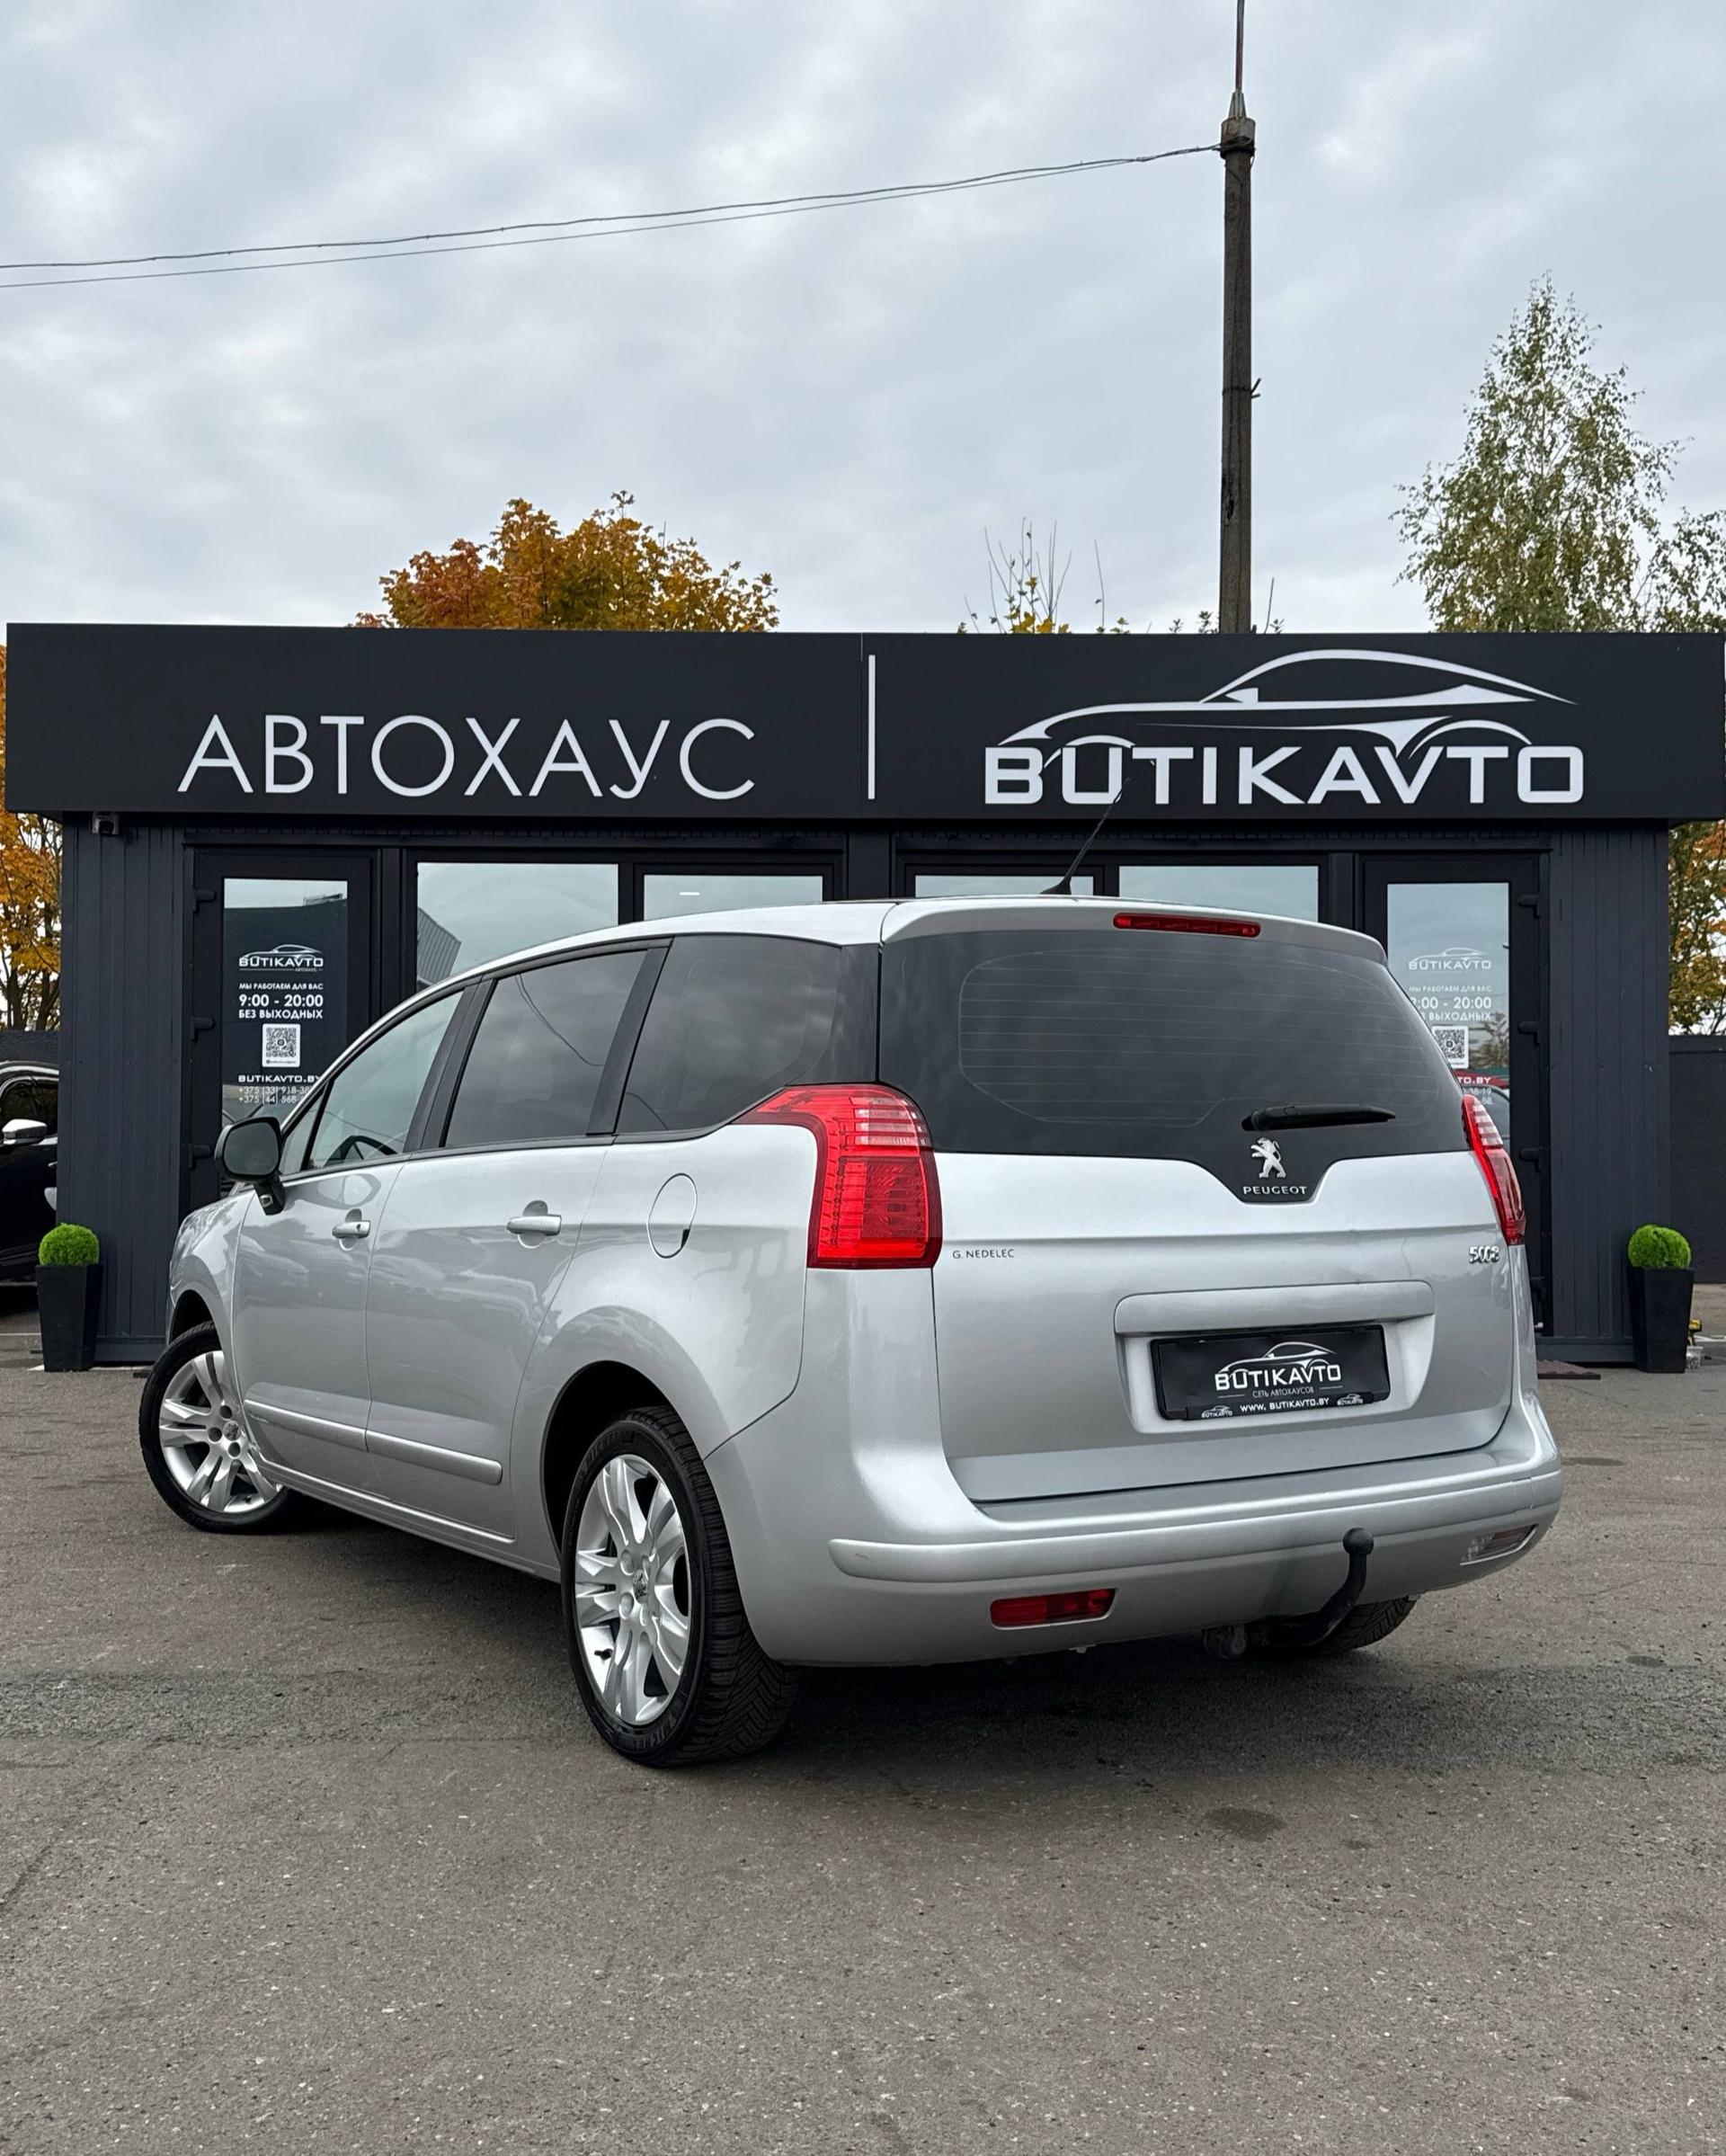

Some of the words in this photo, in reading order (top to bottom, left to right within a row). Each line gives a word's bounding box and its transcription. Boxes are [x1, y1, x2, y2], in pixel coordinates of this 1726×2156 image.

[178, 715, 755, 800] АВТОХАУС
[985, 745, 1584, 805] BUTIKAVTO
[239, 957, 324, 967] BUTIKAVTO
[1409, 959, 1491, 970] BUTIKAVTO
[239, 994, 270, 1007] 9:00
[284, 994, 324, 1007] 20:00
[1454, 997, 1491, 1009] 20:00
[238, 1010, 256, 1019] БЕЗ
[259, 1009, 323, 1020] ВЫХОДНЫХ
[1428, 1011, 1491, 1021] ВЫХОДНЫХ
[1456, 1076, 1491, 1084] TO.BY
[1243, 1186, 1307, 1195] PEUGEOT
[965, 1249, 1014, 1259] NEDELEC
[1214, 1364, 1341, 1391] BUTIKAVTO
[1252, 1389, 1269, 1398] СЕТЬ
[1269, 1397, 1330, 1411] BUTIKAVTO.BY
